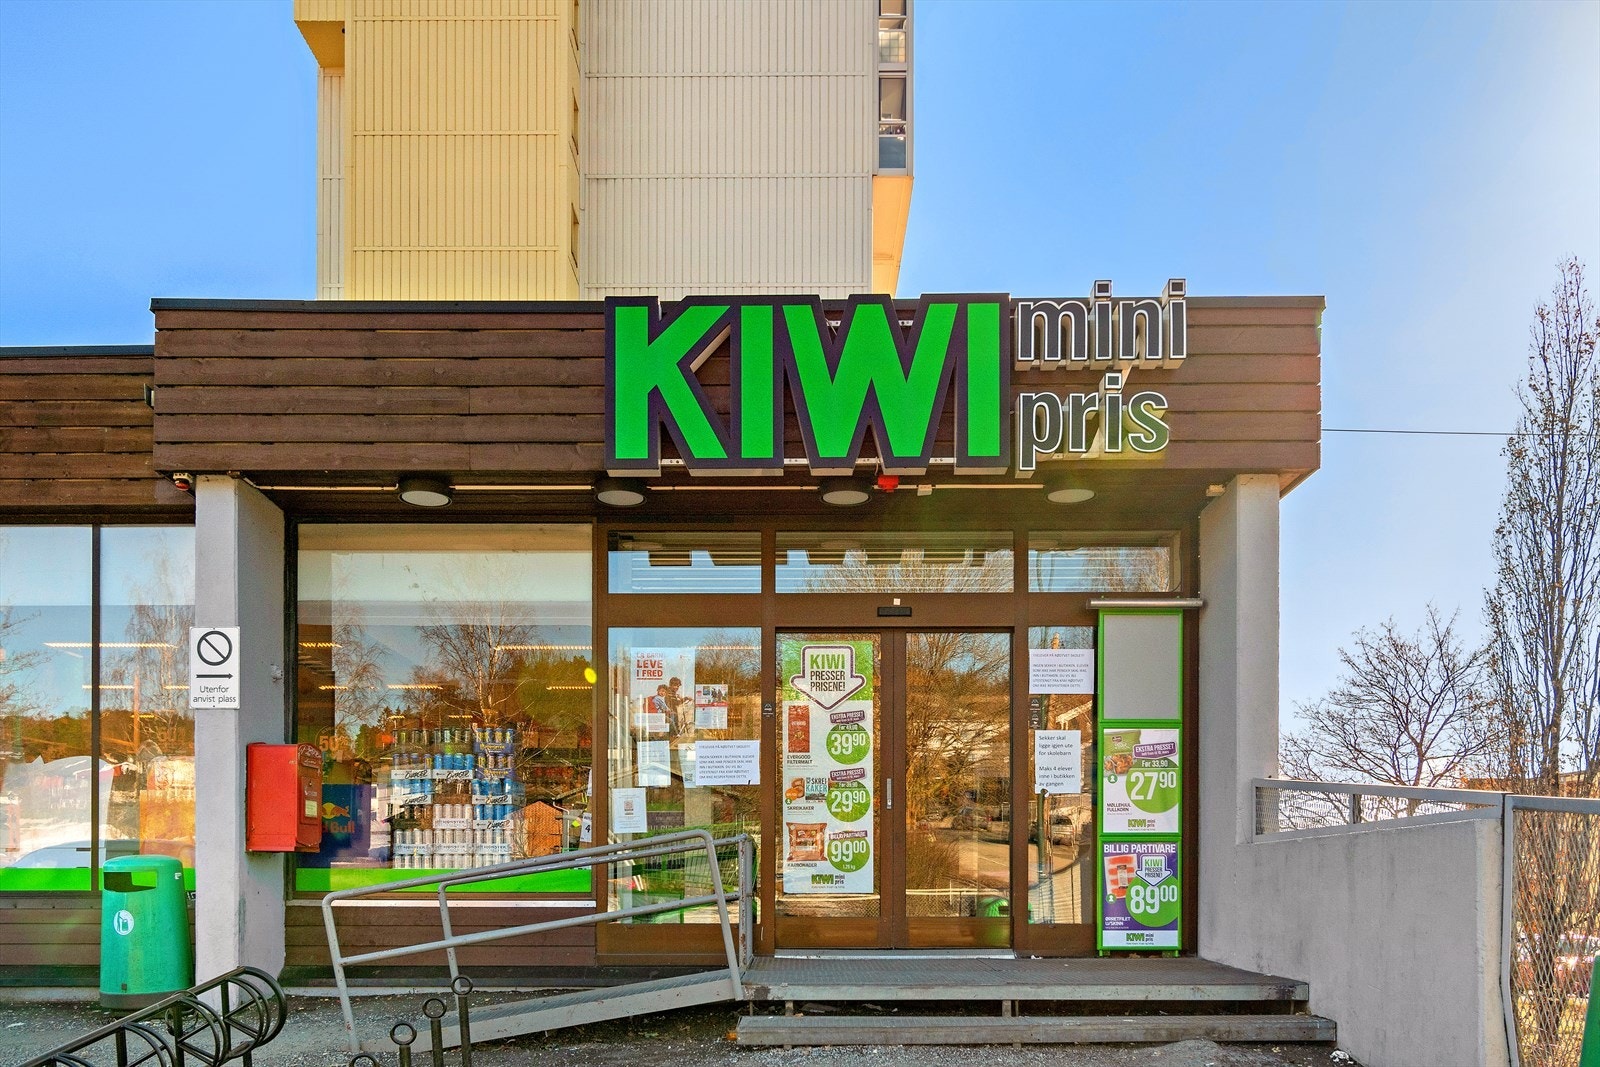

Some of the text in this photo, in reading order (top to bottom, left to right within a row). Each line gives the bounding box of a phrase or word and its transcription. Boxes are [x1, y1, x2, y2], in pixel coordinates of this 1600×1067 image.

[606, 279, 1187, 468] KIWI mini
[1016, 373, 1170, 477] pris
[636, 659, 663, 668] LEVE
[810, 654, 845, 670] KIWI
[810, 671, 845, 681] PRESSER
[200, 685, 229, 693] Utenfor
[810, 682, 846, 692] PRISENE!
[218, 696, 236, 704] plass
[1154, 743, 1174, 751] PRESSET
[330, 820, 355, 833] Bull
[1128, 819, 1146, 827] KIWI
[585, 824, 591, 832] 4
[1104, 844, 1176, 853] BILLIG PARTIVARE
[811, 874, 834, 884] KIWI
[1126, 933, 1145, 941] KIWI
